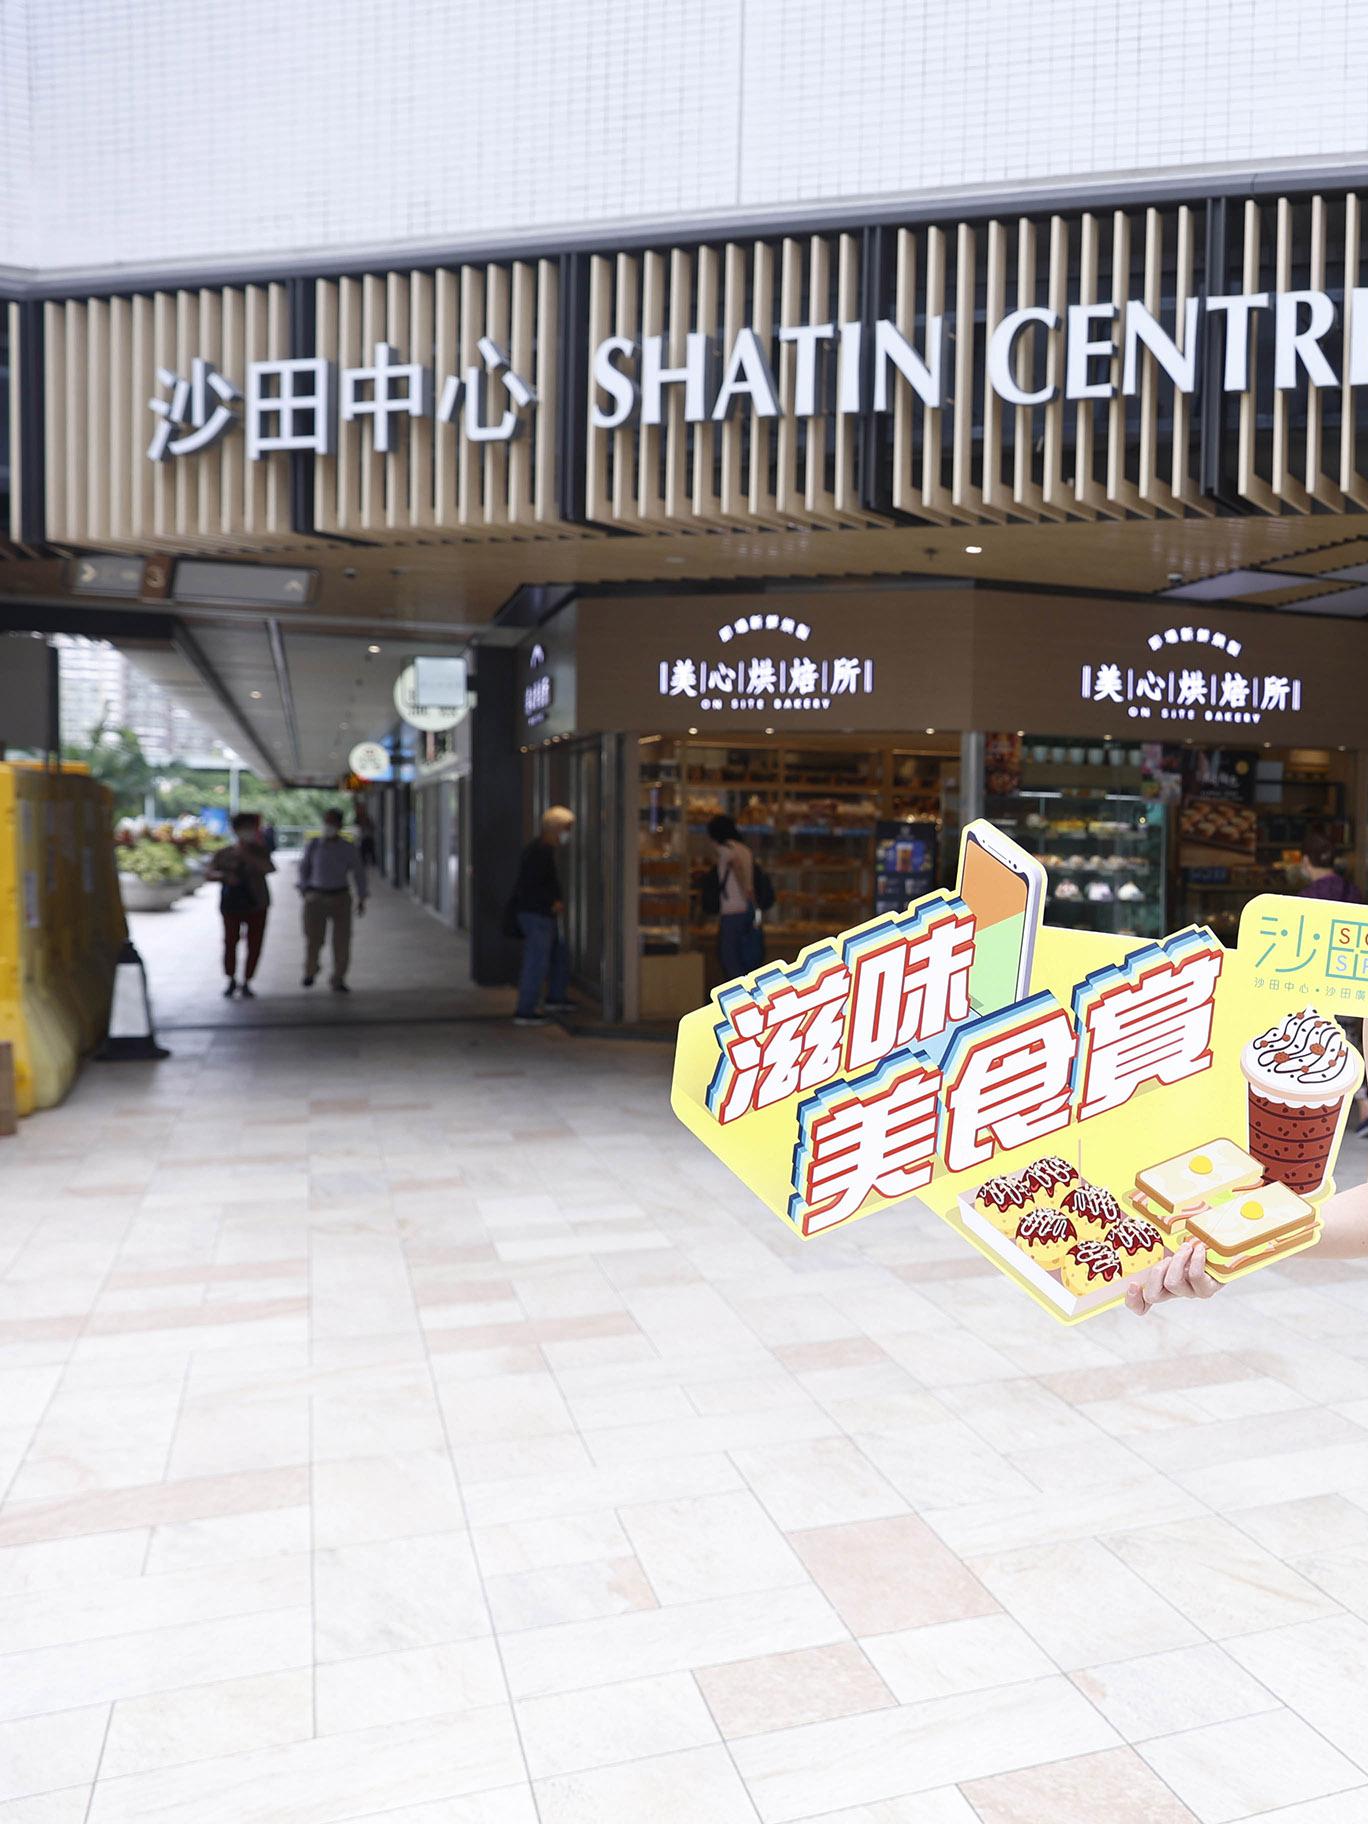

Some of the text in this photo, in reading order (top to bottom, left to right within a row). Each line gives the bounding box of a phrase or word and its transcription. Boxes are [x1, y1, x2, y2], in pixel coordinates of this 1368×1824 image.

[147, 336, 537, 461] 沙田中心
[592, 315, 943, 429] SHATIN
[669, 656, 862, 698] 美心烘焙所
[700, 698, 723, 710] ON
[1093, 663, 1291, 711] 美心烘焙所
[1127, 705, 1151, 718] ON
[718, 913, 977, 1126] 滋味
[801, 948, 1224, 1237] 美食賞
